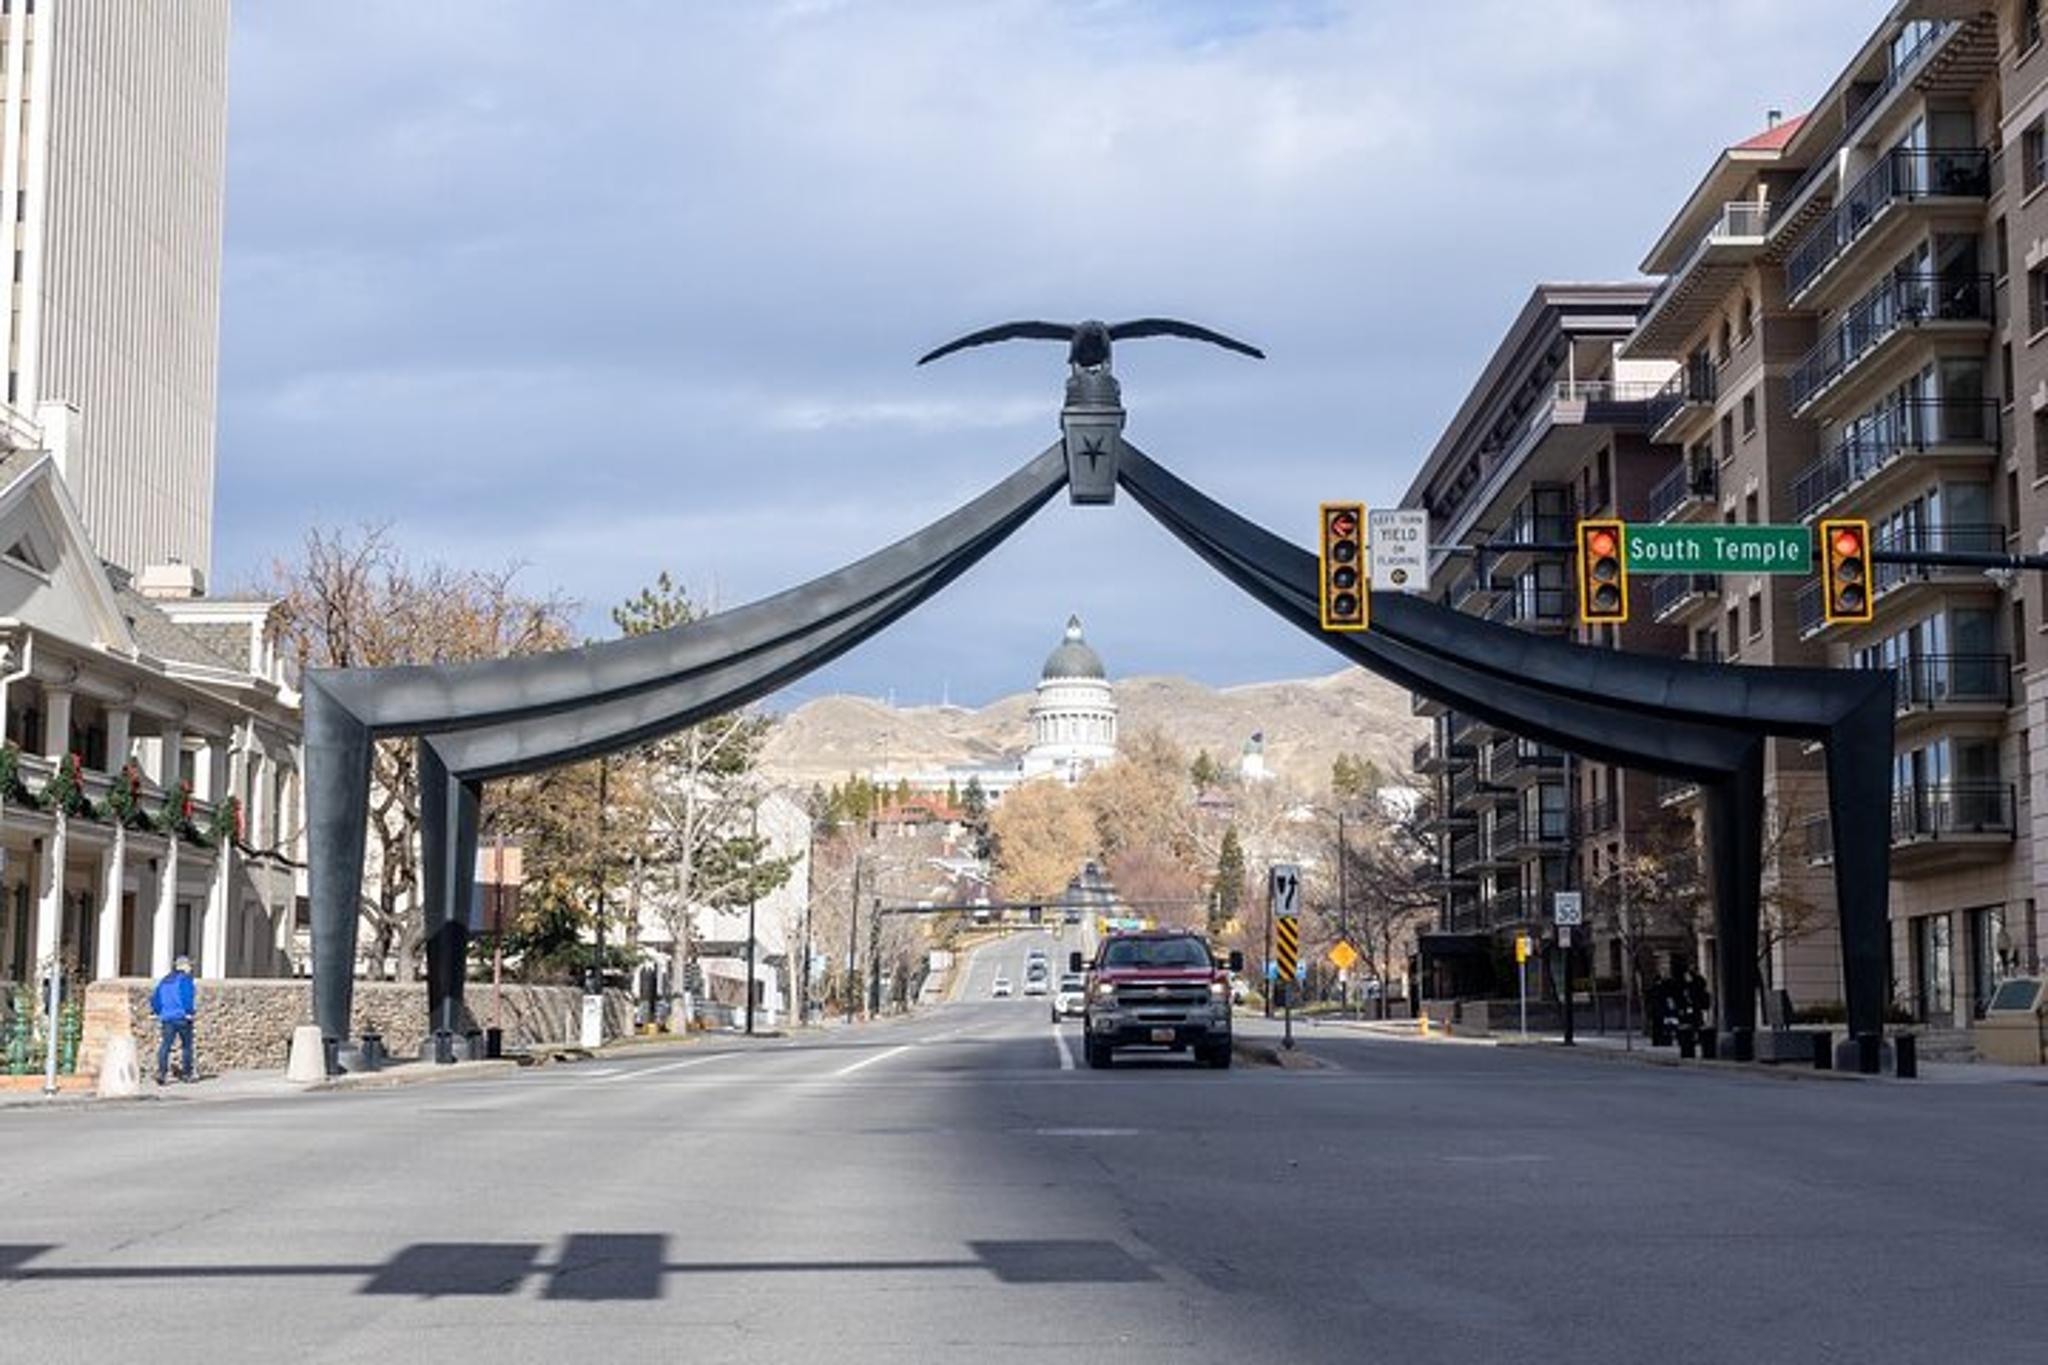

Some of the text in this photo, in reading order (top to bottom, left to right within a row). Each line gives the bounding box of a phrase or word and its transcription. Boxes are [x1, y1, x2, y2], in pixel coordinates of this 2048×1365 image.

[1380, 527, 1417, 541] YIELD
[1631, 537, 1799, 565] South Temple
